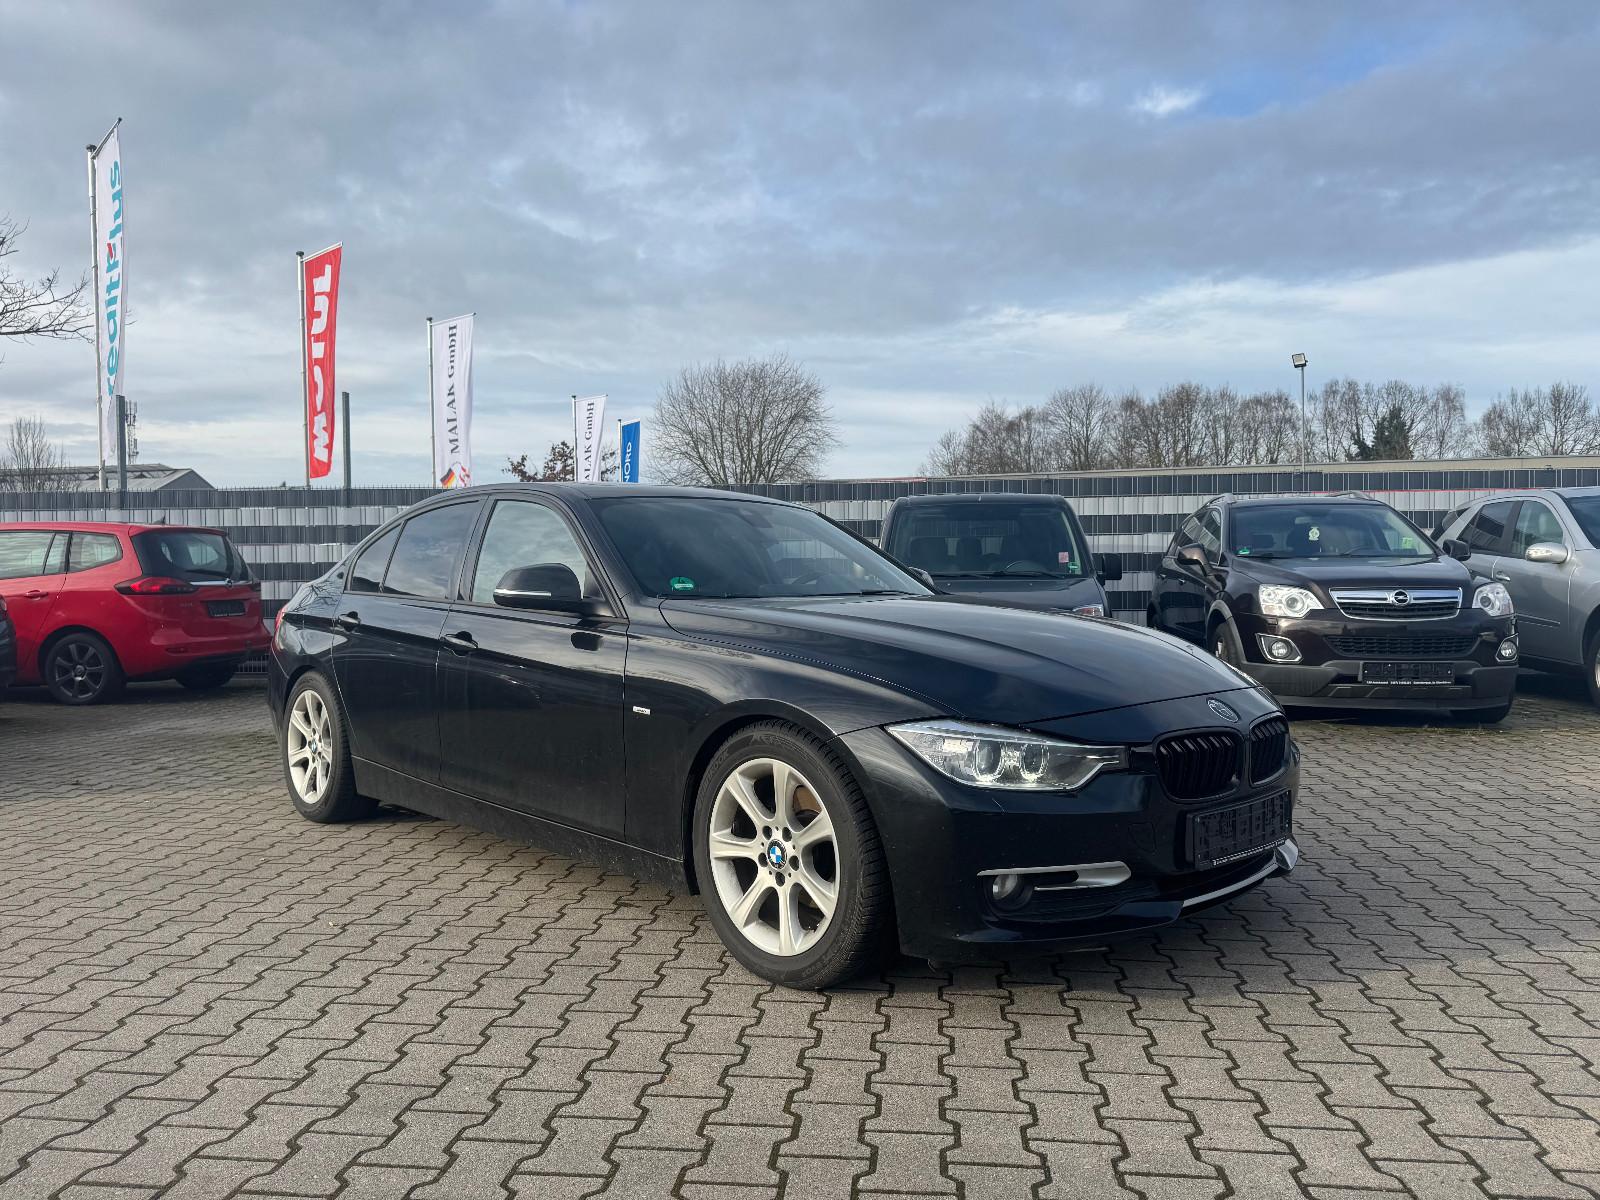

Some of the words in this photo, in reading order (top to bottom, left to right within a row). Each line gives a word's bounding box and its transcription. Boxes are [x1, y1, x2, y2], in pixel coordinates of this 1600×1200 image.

[447, 323, 458, 379] GmbH
[446, 383, 460, 454] MALAK
[584, 402, 595, 440] GmbH
